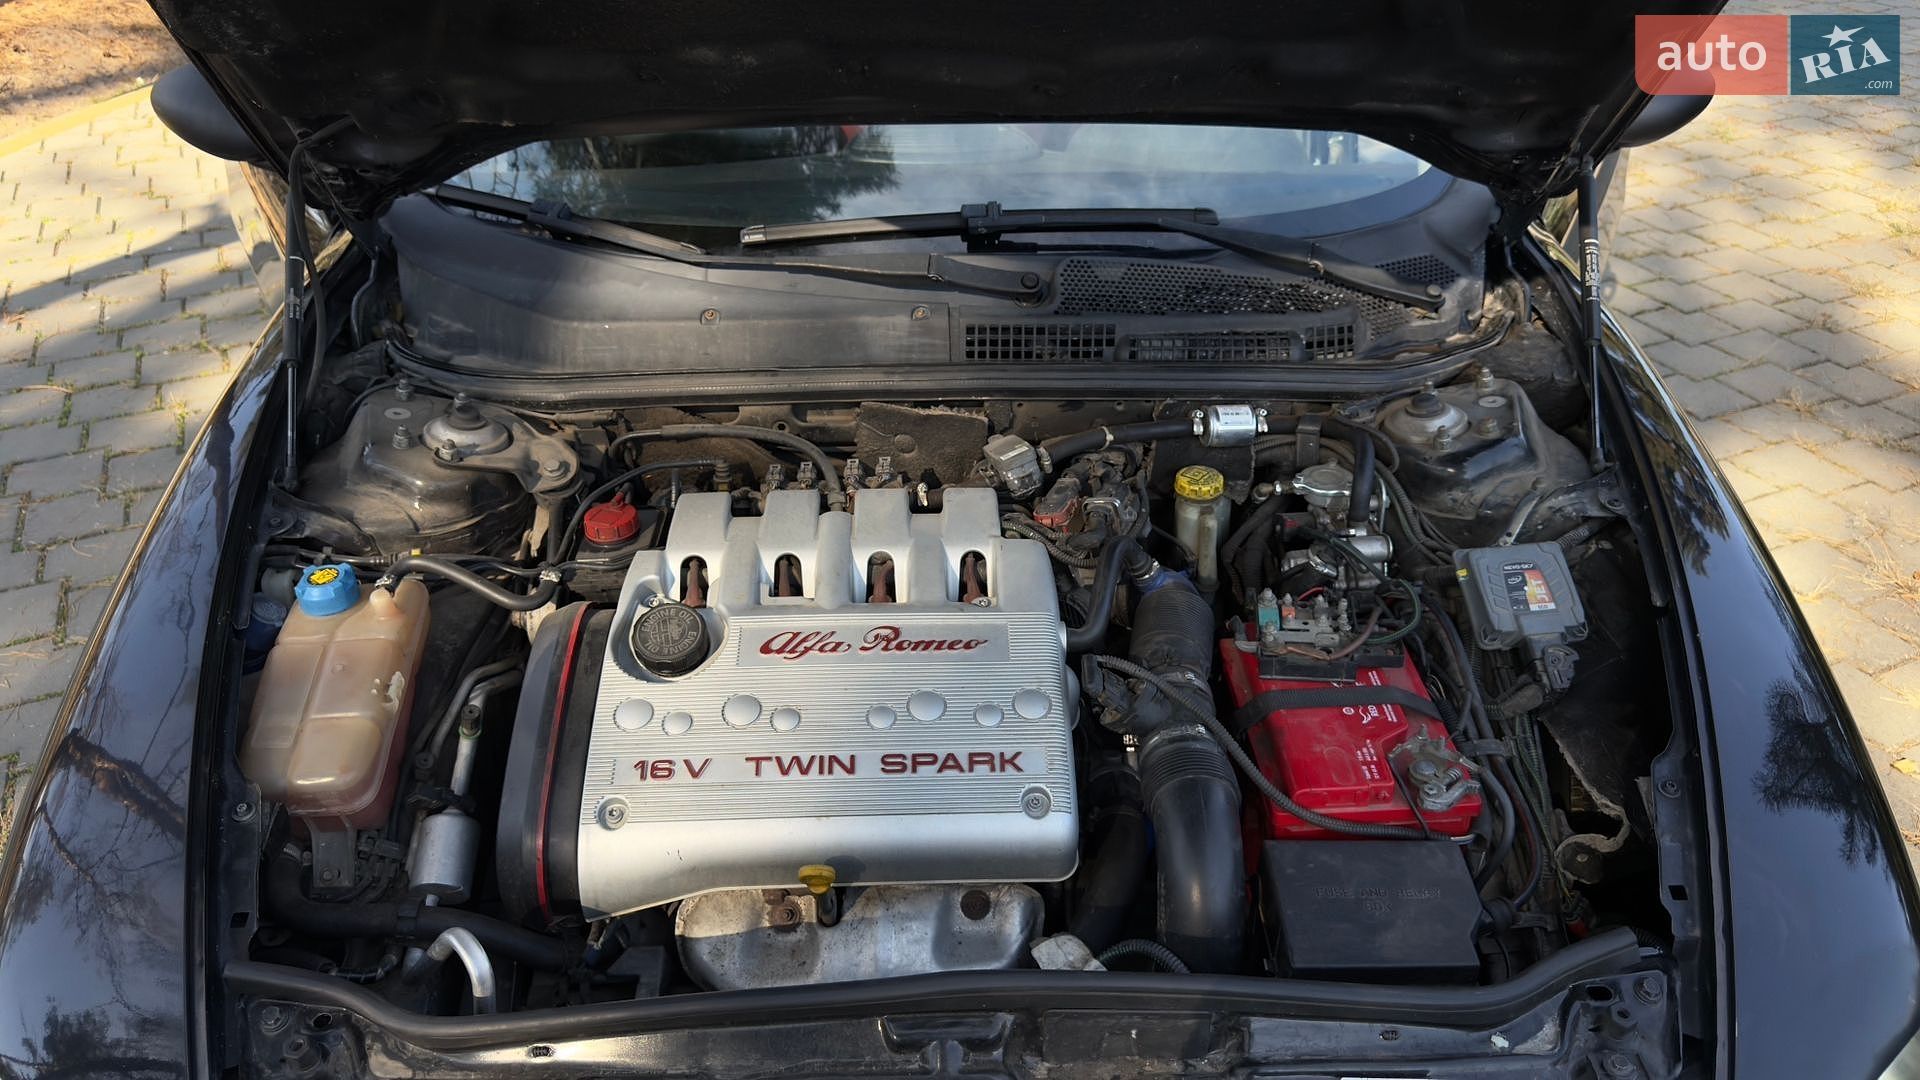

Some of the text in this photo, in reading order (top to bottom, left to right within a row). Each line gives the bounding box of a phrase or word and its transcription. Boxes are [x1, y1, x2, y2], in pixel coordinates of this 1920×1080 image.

[641, 608, 694, 632] ENGINE OIL
[644, 631, 697, 655] ENGINE OIL
[760, 625, 988, 659] Alfa Romeo
[745, 754, 856, 777] TWIN
[880, 751, 1024, 775] SPARK
